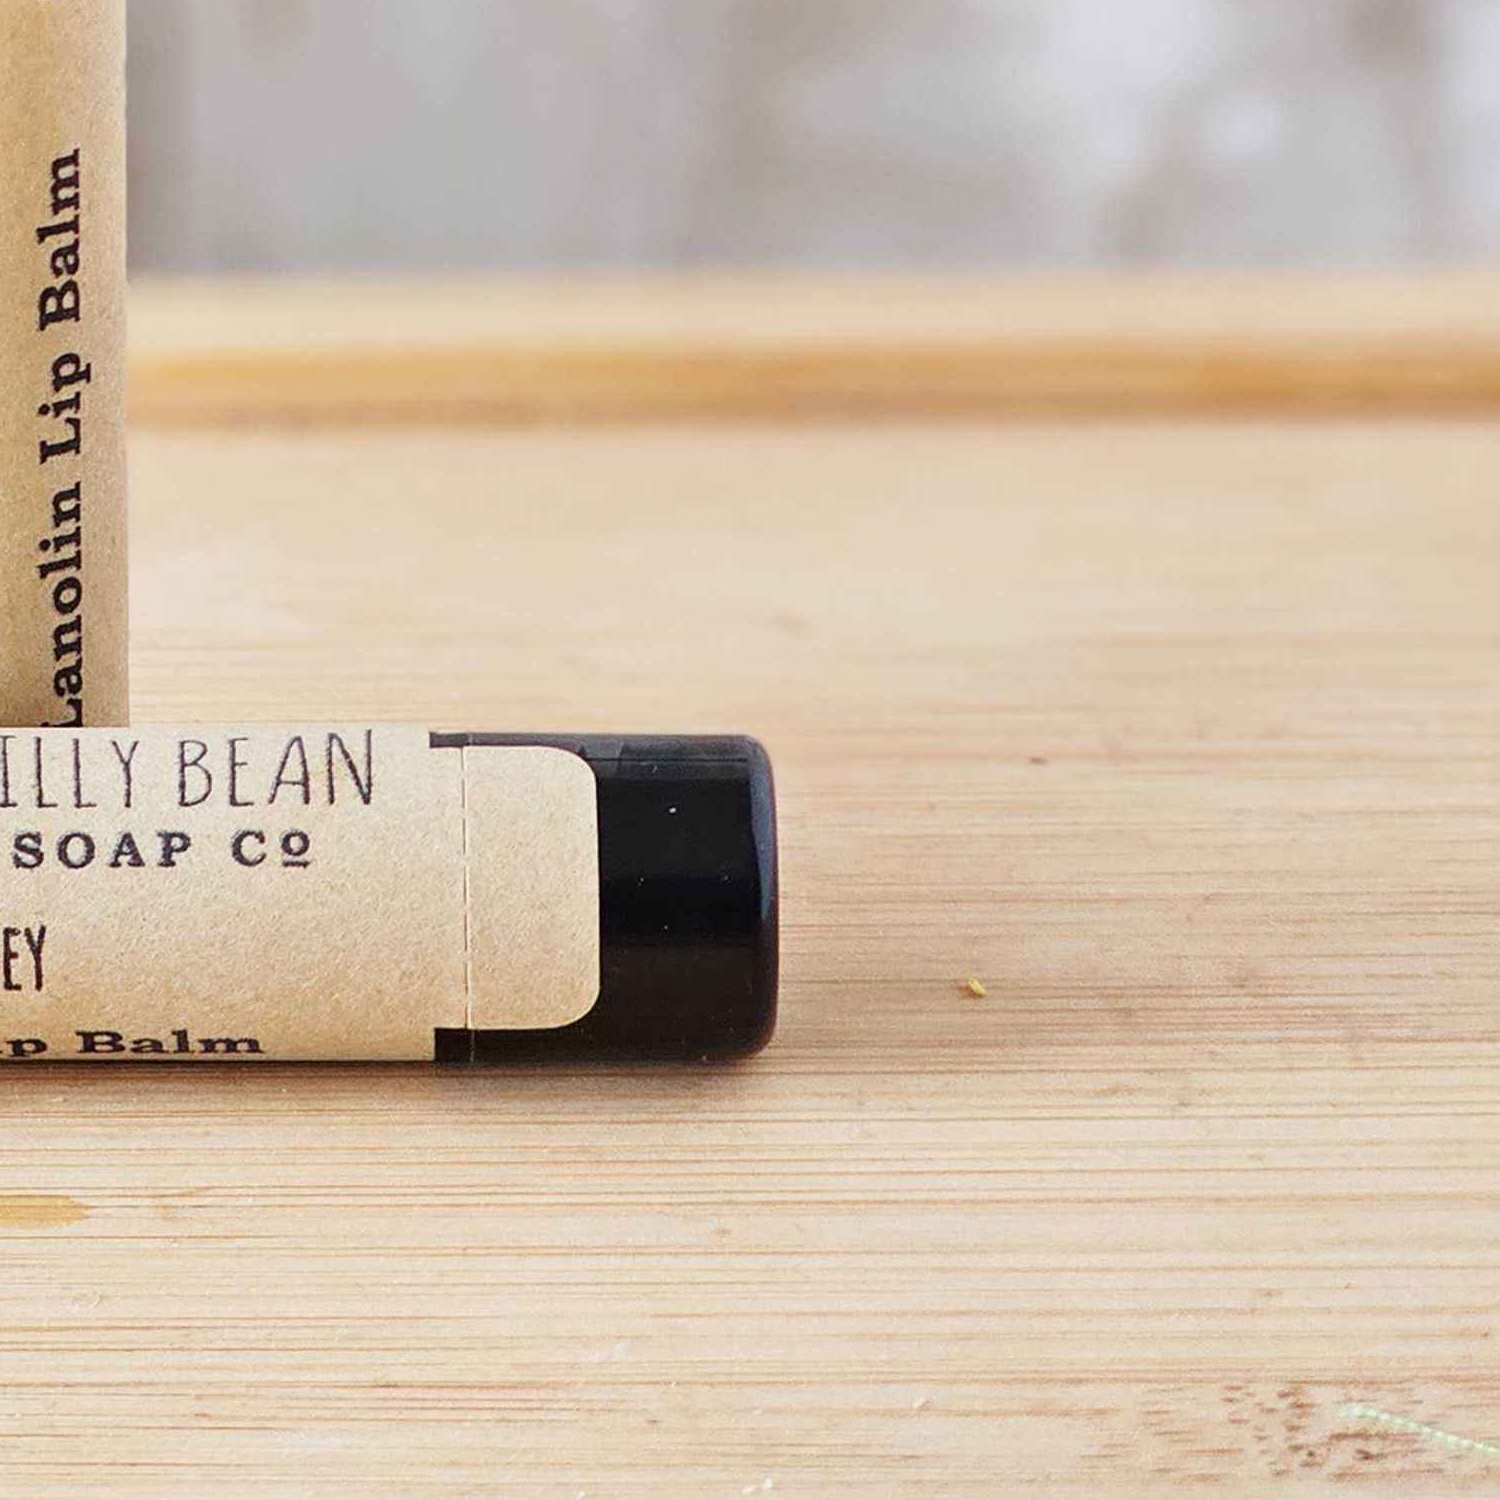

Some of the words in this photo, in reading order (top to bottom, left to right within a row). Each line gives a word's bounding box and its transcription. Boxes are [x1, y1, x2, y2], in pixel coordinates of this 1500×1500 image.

[36, 147, 81, 333] Balm
[37, 352, 92, 466] Lip
[38, 480, 84, 727] Lanolin
[177, 729, 374, 808] BEAN
[11, 829, 192, 870] SOAP
[75, 1028, 266, 1055] Balm
